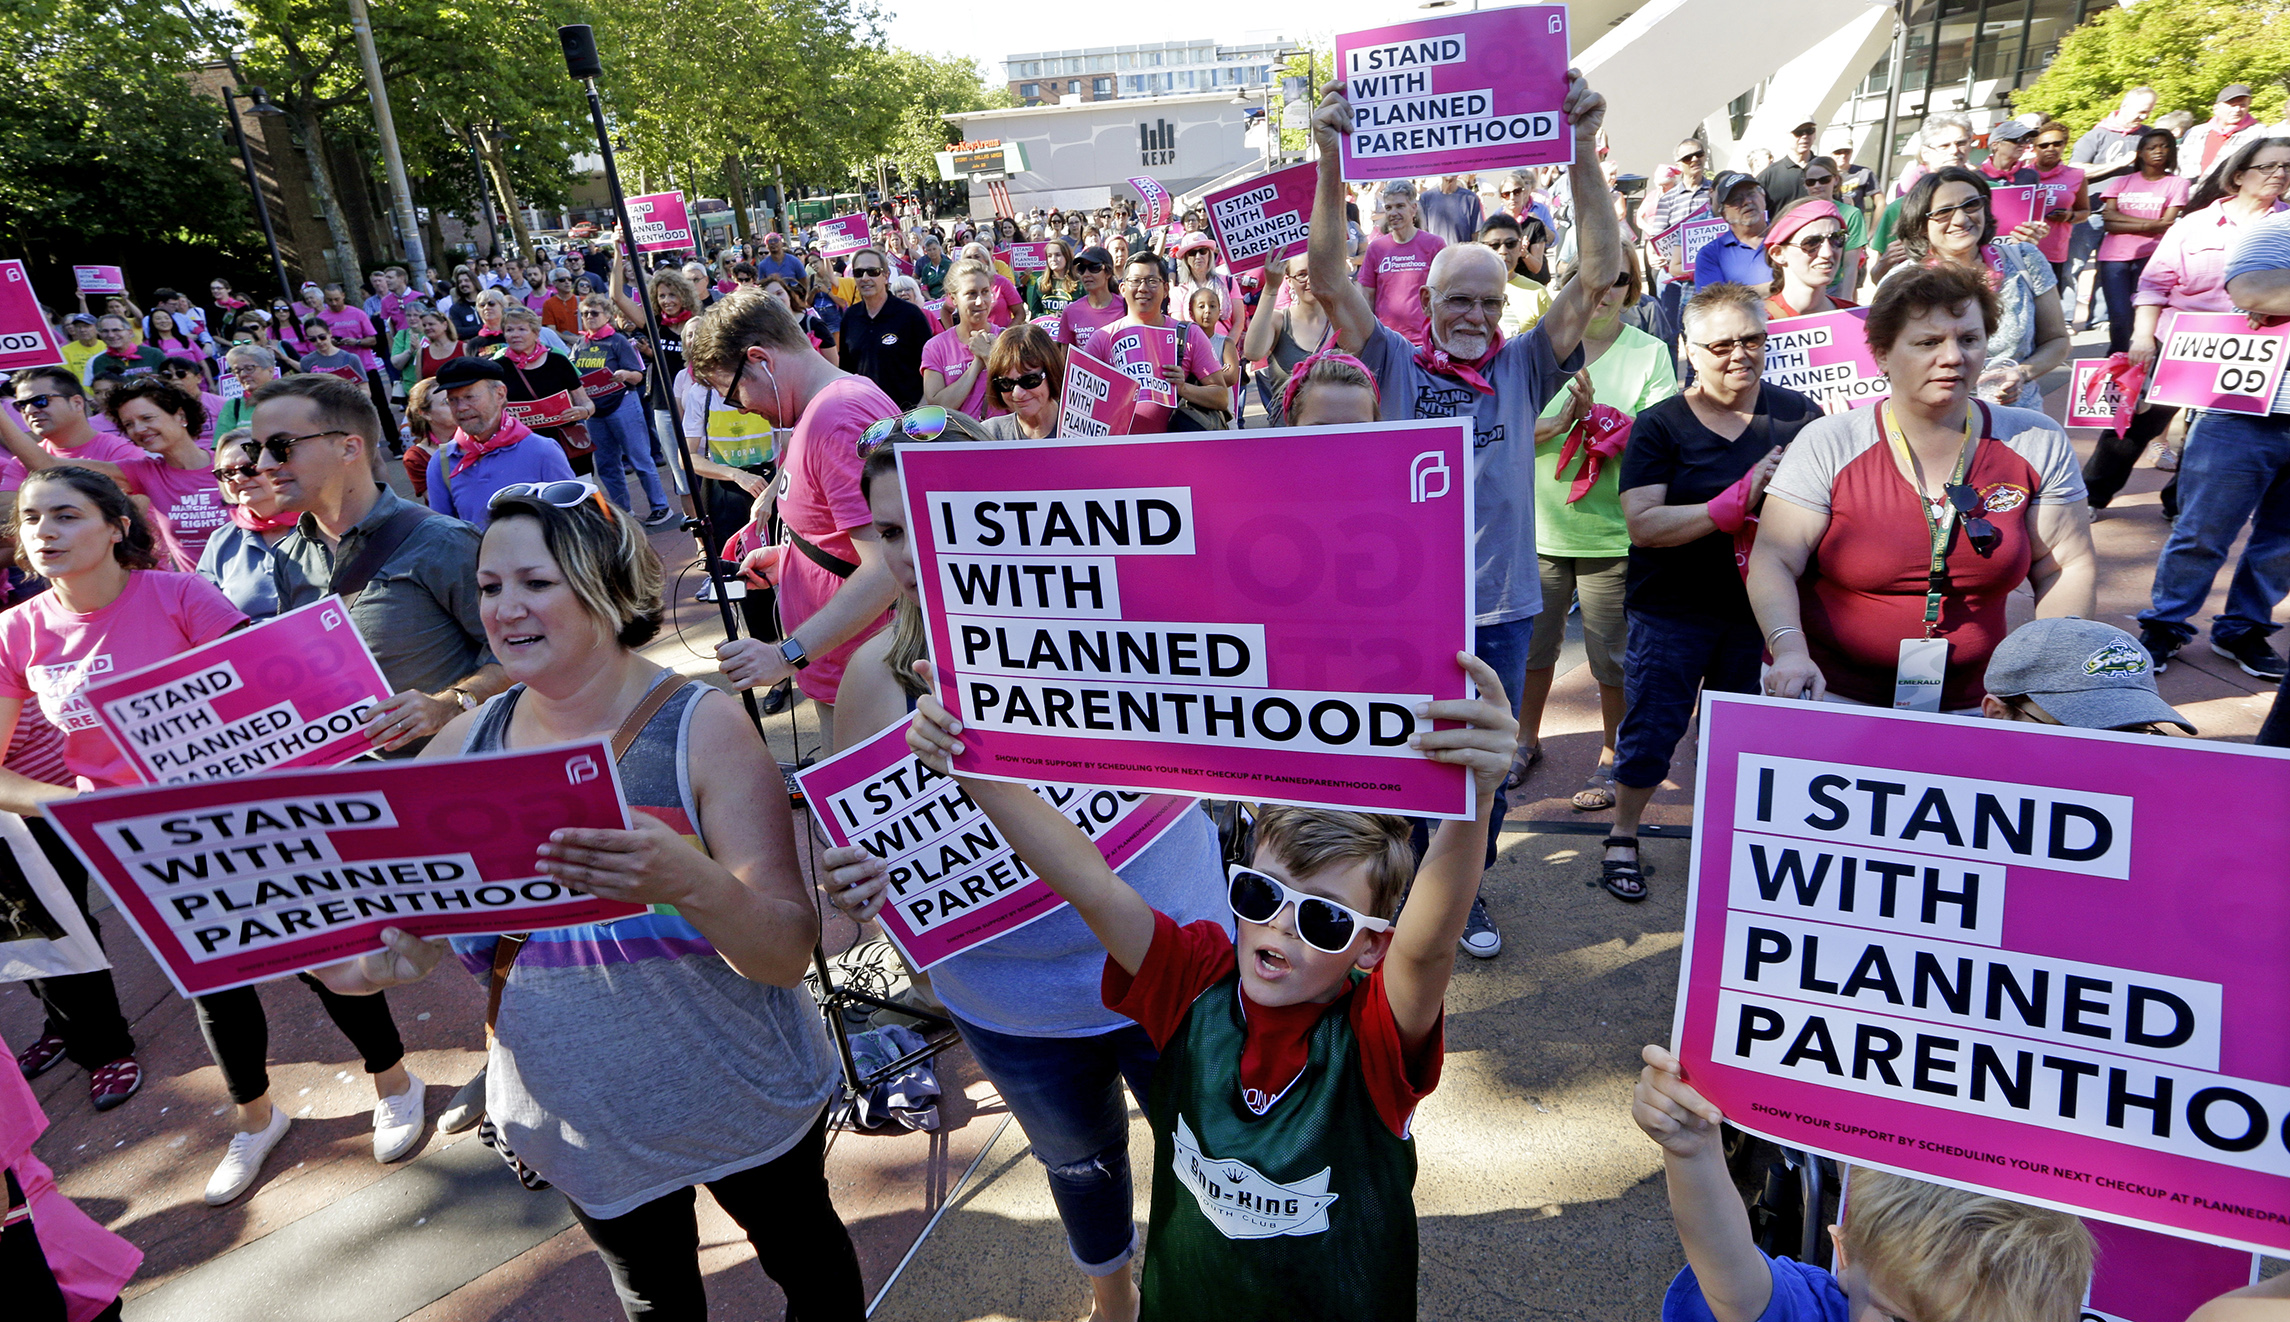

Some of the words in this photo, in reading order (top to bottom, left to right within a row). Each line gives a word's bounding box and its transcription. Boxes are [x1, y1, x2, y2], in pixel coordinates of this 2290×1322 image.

[1353, 54, 1358, 72] I
[1369, 39, 1461, 70] STAND
[1353, 71, 1425, 99] WITH
[1356, 94, 1486, 128] PLANNED
[1357, 116, 1552, 154] PARENTHOOD
[1142, 150, 1175, 166] KEXP
[630, 204, 651, 213] TAND
[1217, 205, 1222, 216] I
[1225, 188, 1275, 213] STAND
[632, 224, 663, 233] ANNED
[825, 223, 845, 231] STAND
[1220, 208, 1261, 230] WITH
[1226, 214, 1296, 246] PLANNED
[1694, 225, 1727, 235] STAND
[635, 231, 685, 243] RENTHOOD
[1232, 225, 1310, 259] PARENTHO
[1688, 235, 1714, 244] WITH
[1112, 337, 1138, 354] AND
[1765, 331, 1827, 352] STAND
[2174, 336, 2278, 363] STORM!
[575, 358, 606, 368] STORM
[1071, 368, 1074, 383] I
[1076, 370, 1107, 398] STAND
[1138, 377, 1169, 392] THOOD
[1426, 388, 1471, 404] STAND
[2220, 368, 2266, 392] GO
[1068, 389, 1092, 413] WITH
[1420, 400, 1454, 417] WITH
[1064, 411, 1107, 436] PLANNED
[724, 448, 755, 457] STORM
[168, 510, 227, 520] WOMEN'S
[181, 494, 210, 505] WE
[181, 518, 225, 528] RIGHTS
[941, 501, 958, 547] I
[975, 500, 1183, 548] STAND
[1938, 532, 1947, 555] STORM
[1934, 556, 1944, 572] ATTLE
[948, 563, 1104, 610] WITH
[960, 624, 1252, 679] PLANNED
[113, 706, 128, 725] I
[128, 670, 233, 719] STAND
[130, 709, 210, 746] WITH
[969, 682, 1417, 748] PARENTHOOD
[152, 709, 292, 772] PLANNED
[168, 704, 374, 784] PARENTHOOD
[994, 754, 1020, 764] SHOW
[1020, 756, 1044, 766] YOUR
[1044, 758, 1083, 769] SUPPORT
[1084, 762, 1096, 770] BY
[1097, 762, 1152, 773] SCHEDULING
[1154, 766, 1180, 775] YOUR
[1180, 768, 1205, 776] NEXT
[1206, 770, 1250, 780] CHECKUP
[1250, 773, 1262, 781] AT
[1264, 774, 1402, 792] PLANNEDPARENTHOOD.ORG
[838, 798, 860, 828] I
[862, 757, 952, 816] STA
[116, 826, 146, 854] I
[160, 798, 382, 846] STAND
[858, 784, 978, 860] WITH
[1117, 796, 1178, 851] PLANNEDPARENTHOOD.ORG
[1756, 767, 1775, 822] I
[1803, 773, 2114, 862] STAND
[140, 838, 322, 885] WITH
[170, 861, 466, 921] PLANNED
[1748, 843, 1980, 930] WITH
[192, 880, 587, 952] PARENTHOO
[965, 926, 982, 935] YOUR
[982, 914, 1008, 929] SUPPORT
[1017, 891, 1054, 912] SCHEDULING
[1742, 926, 2196, 1049] PLANNED
[1734, 1003, 2290, 1154] PARENTHO
[1750, 1102, 1793, 1122] SHOW
[1794, 1113, 1832, 1131] YOUR
[1833, 1122, 1896, 1145] SUPPORT
[1897, 1136, 1916, 1148] BY
[1918, 1139, 2006, 1167] SCHEDULING
[2008, 1157, 2050, 1175] YOUR
[2053, 1166, 2092, 1184] NEXT
[2094, 1175, 2168, 1200] CHECKUP
[2170, 1192, 2190, 1204] AT
[2192, 1196, 2290, 1226] PLANNEDPA
[1203, 1197, 1234, 1218] OUTH
[1242, 1214, 1277, 1229] CLUB
